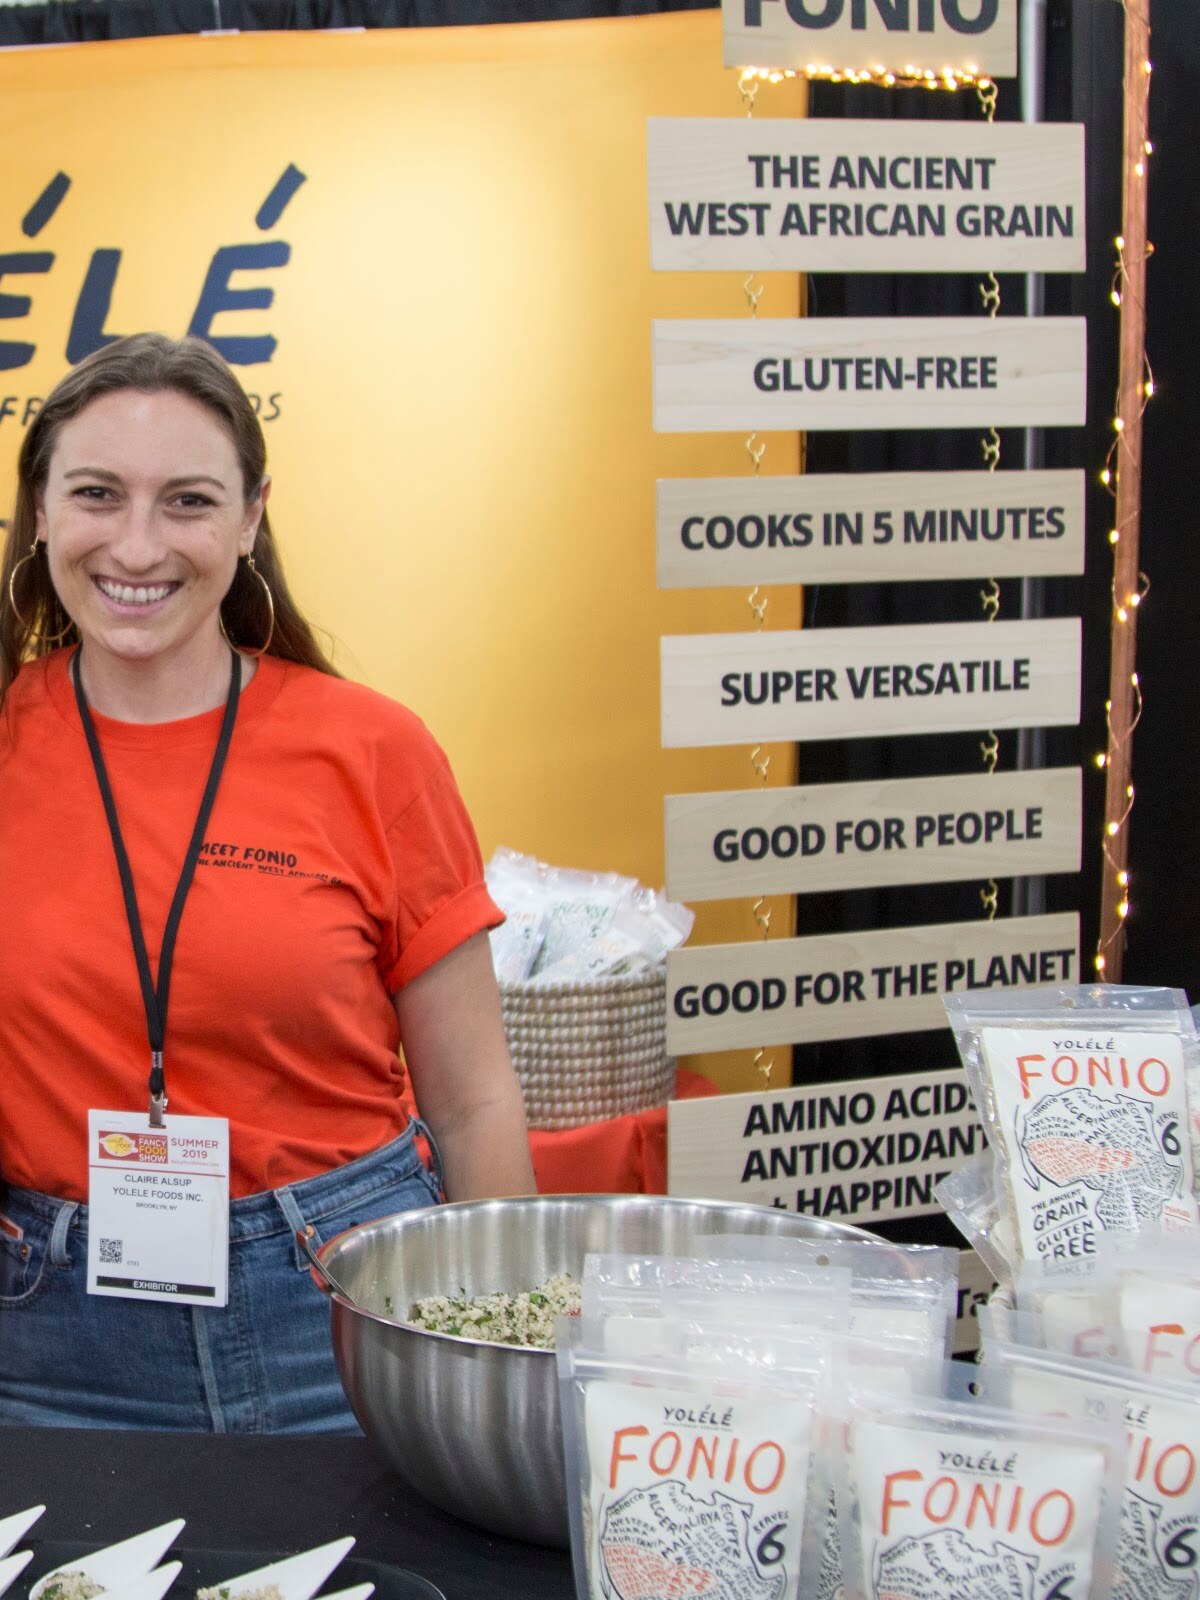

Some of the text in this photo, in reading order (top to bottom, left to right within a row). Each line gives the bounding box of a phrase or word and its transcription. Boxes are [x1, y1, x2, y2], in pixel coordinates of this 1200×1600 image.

[748, 154, 997, 190] THE ANCIENT
[664, 202, 1074, 238] WEST AFRICAN GRAIN
[753, 356, 999, 392] GLUTEN-FREE
[680, 506, 1066, 550] COOKS IN 5 MINUTES
[720, 658, 1031, 706] SUPER VERSATILE
[712, 807, 1043, 863] GOOD FOR PEOPLE
[199, 842, 298, 868] MEET FONIO
[213, 859, 255, 870] ANCIENT
[258, 865, 285, 874] WEST
[673, 948, 1077, 1019] GOOD FOR THE PLANET
[1054, 1037, 1115, 1050] YOLÉLÉ
[1016, 1054, 1170, 1100] FONIO
[742, 1092, 876, 1138] AMINO
[1031, 1116, 1075, 1128] WESTERN
[1102, 1107, 1129, 1120] LIBYA
[139, 1138, 166, 1147] FANCY
[139, 1146, 167, 1155] FOOD
[171, 1137, 219, 1149] SUMMER
[1162, 1121, 1180, 1155] 6
[139, 1154, 166, 1163] SHOW
[182, 1149, 208, 1159] 2019
[741, 1123, 990, 1183] ANTIOXIDANT
[124, 1174, 192, 1187] CLAIRE ALSUP
[113, 1187, 204, 1203] YOLELE FOODS INC.
[797, 1171, 950, 1217] HAPPIN
[1031, 1188, 1082, 1212] THE ANCIENT
[1034, 1196, 1089, 1232] GRAIN
[1037, 1220, 1094, 1252] GLUTEN
[133, 1280, 178, 1293] EXHIBITOR
[664, 1404, 733, 1427] YOLÉLÉ
[608, 1424, 785, 1495] FONIO
[938, 1449, 1017, 1473] YOLÉLÉ
[649, 1493, 691, 1535] ALGERIA
[688, 1511, 721, 1528] LIBYA
[880, 1469, 1075, 1547] FONIO
[610, 1517, 656, 1533] WESTERN
[720, 1502, 739, 1545] EGYPT
[754, 1510, 790, 1535] SERVES
[757, 1523, 787, 1566] 6
[1164, 1528, 1198, 1569] 6
[967, 1563, 1003, 1579] LIBYA
[1039, 1562, 1076, 1587] SERVES
